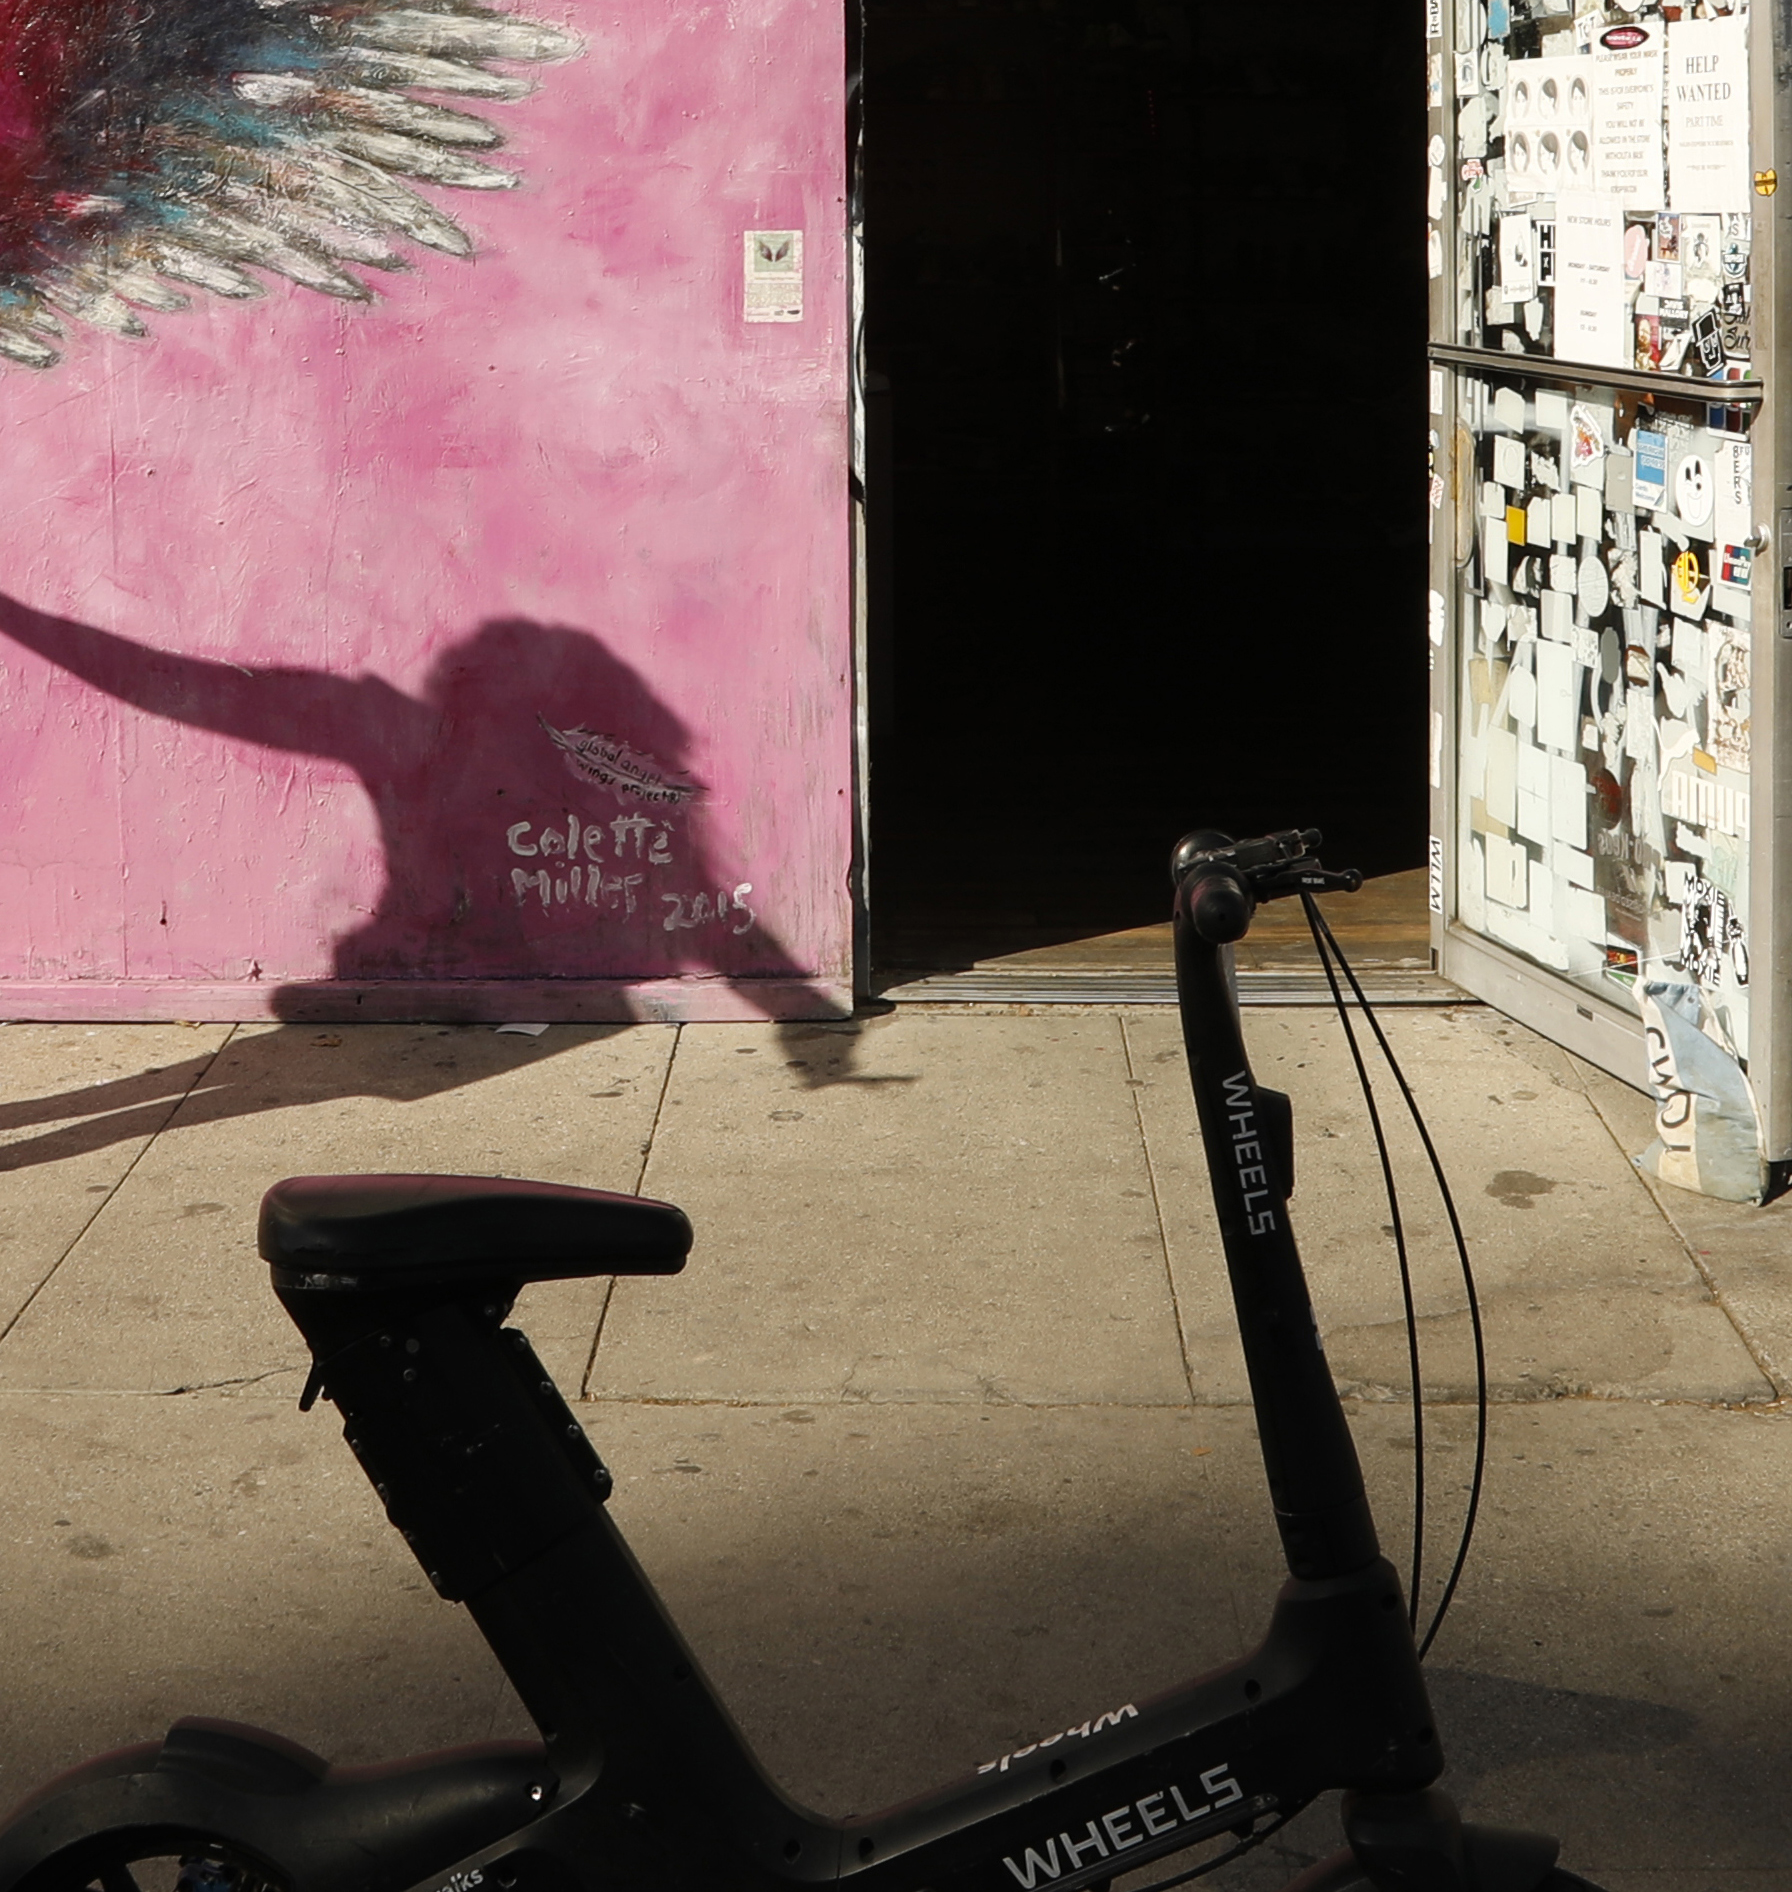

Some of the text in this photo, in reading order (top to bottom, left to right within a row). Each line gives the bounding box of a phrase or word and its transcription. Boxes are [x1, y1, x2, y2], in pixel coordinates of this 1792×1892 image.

[1686, 55, 1719, 75] HELP
[1677, 82, 1732, 103] WANTED
[1686, 117, 1704, 128] PART
[506, 812, 673, 864] Colette
[1683, 870, 1726, 906] MOXIE
[1222, 1070, 1276, 1235] WHEELS
[1002, 1763, 1244, 1890] WHEELS
